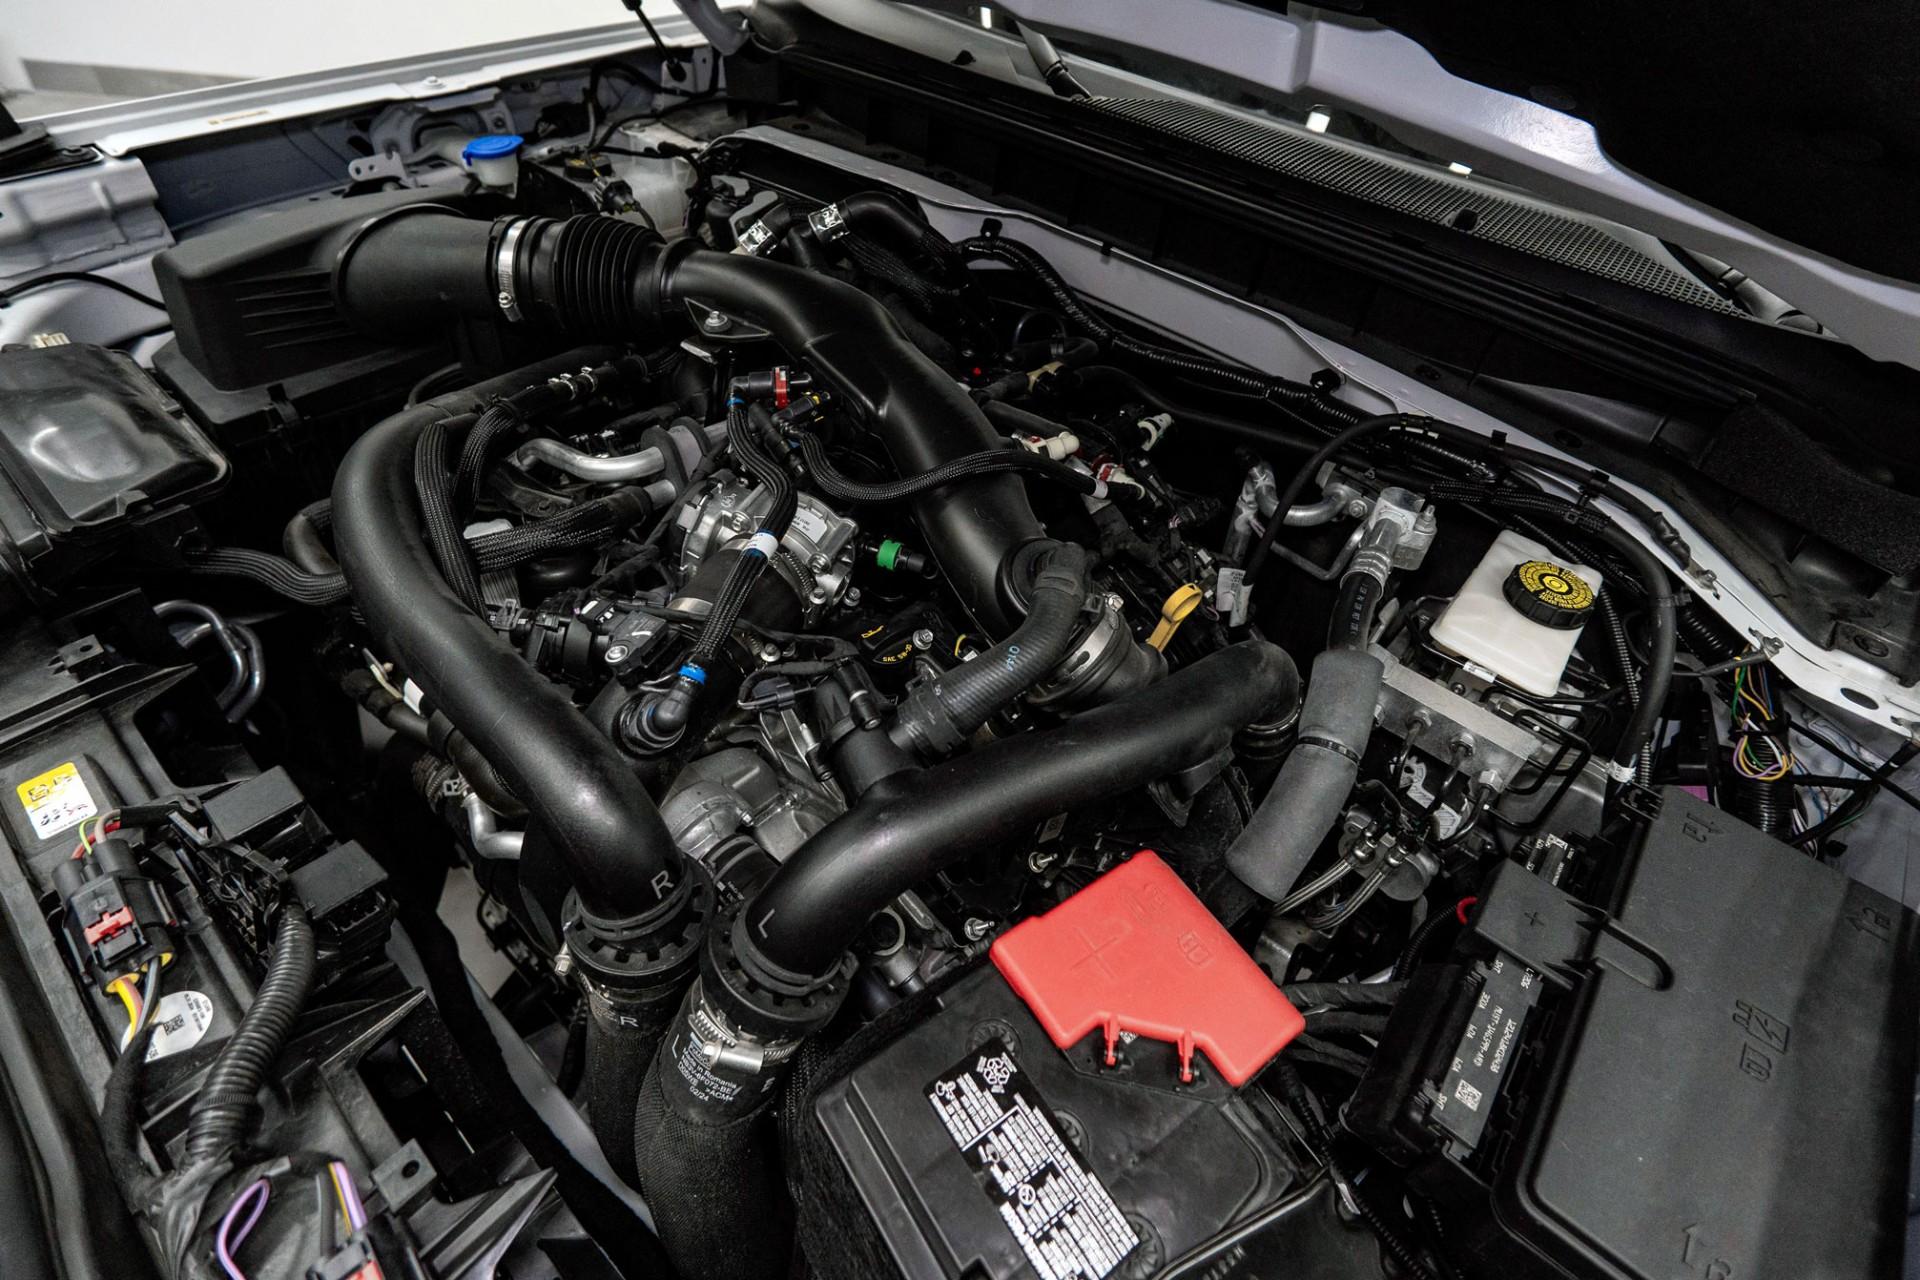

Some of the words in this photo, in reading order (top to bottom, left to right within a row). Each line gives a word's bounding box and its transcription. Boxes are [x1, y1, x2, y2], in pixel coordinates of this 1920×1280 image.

[651, 870, 674, 899] R
[758, 908, 776, 938] L
[620, 1015, 640, 1028] R
[671, 1033, 680, 1060] L
[704, 1070, 738, 1090] Romania
[689, 1084, 710, 1102] 02/24
